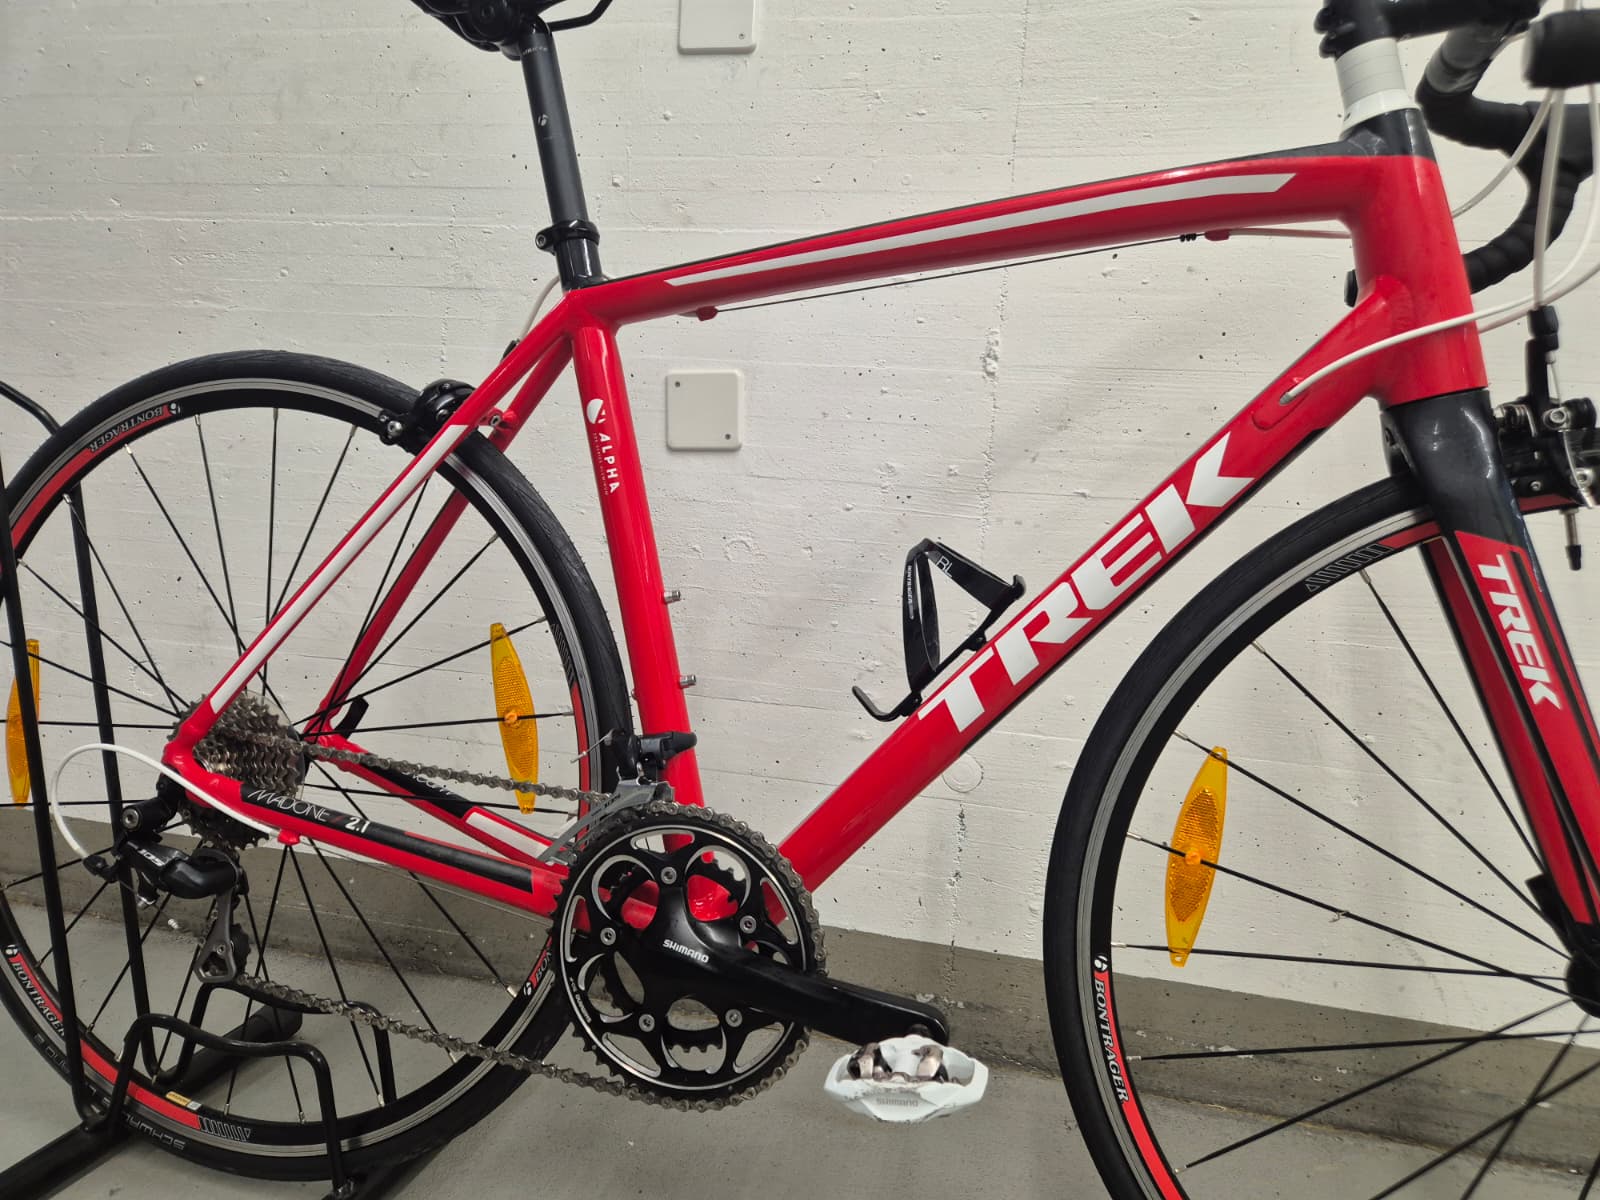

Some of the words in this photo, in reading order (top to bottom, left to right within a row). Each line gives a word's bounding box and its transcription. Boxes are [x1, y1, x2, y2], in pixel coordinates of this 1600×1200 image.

[90, 406, 163, 453] BONTRAGER
[599, 432, 620, 493] ALPHA
[918, 431, 1255, 733] TREK
[936, 556, 952, 578] RL
[1478, 554, 1562, 710] TREK
[247, 789, 330, 823] MADONE
[345, 816, 370, 834] 2.1
[663, 938, 710, 963] SHIMANO
[1095, 978, 1129, 1102] BONTRAGER
